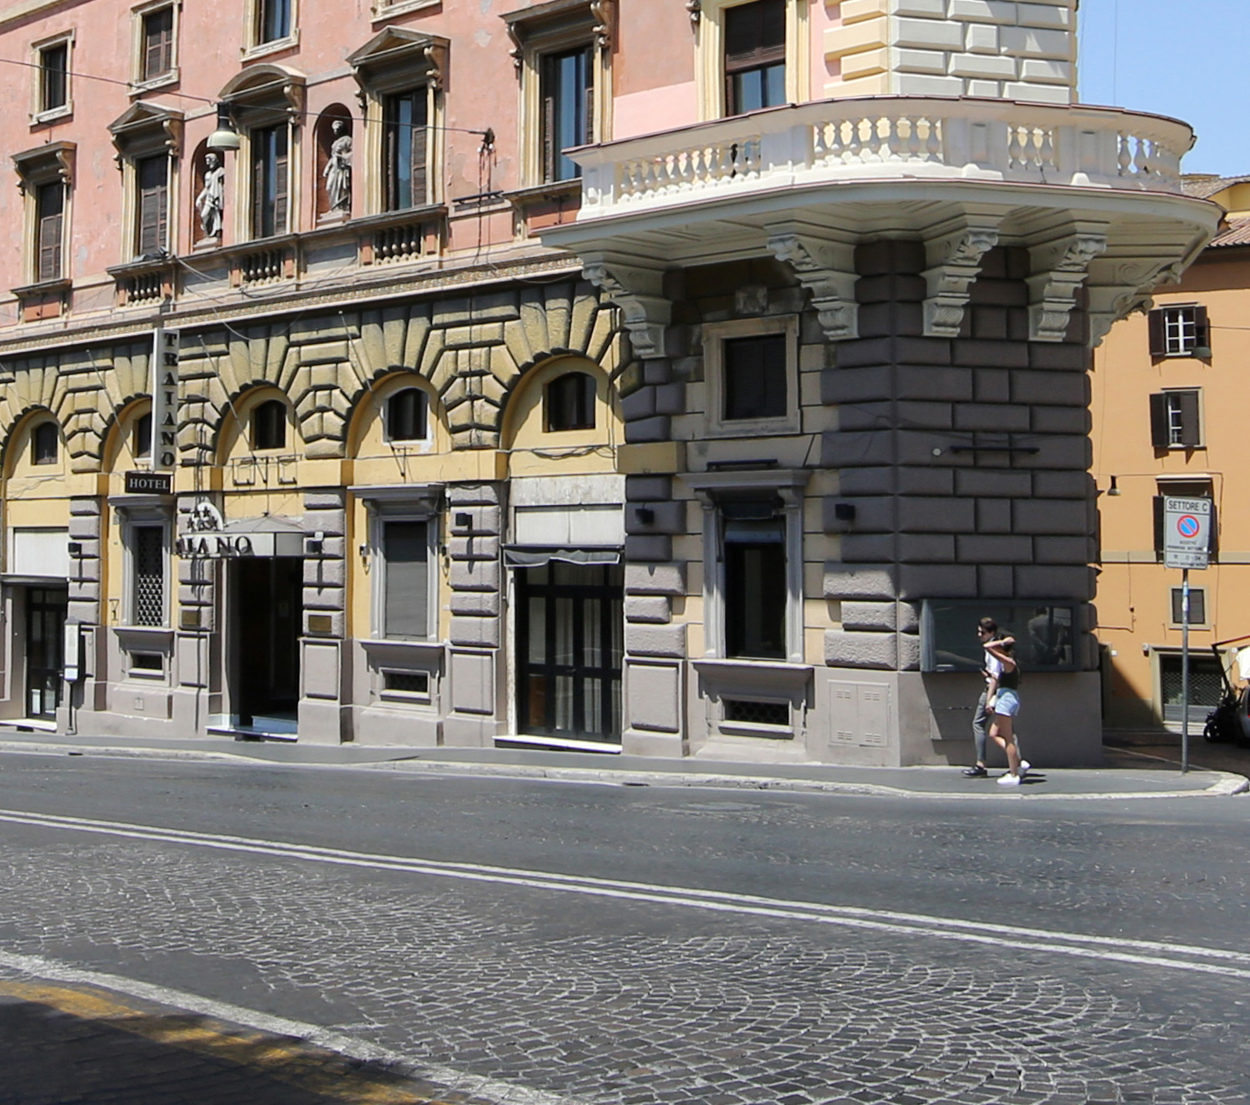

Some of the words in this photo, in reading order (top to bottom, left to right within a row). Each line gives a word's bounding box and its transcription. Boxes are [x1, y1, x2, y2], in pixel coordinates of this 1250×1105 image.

[161, 333, 178, 467] TRAIANO
[129, 477, 169, 490] HOTEL
[1168, 500, 1199, 511] SETTORE
[1202, 503, 1208, 512] C
